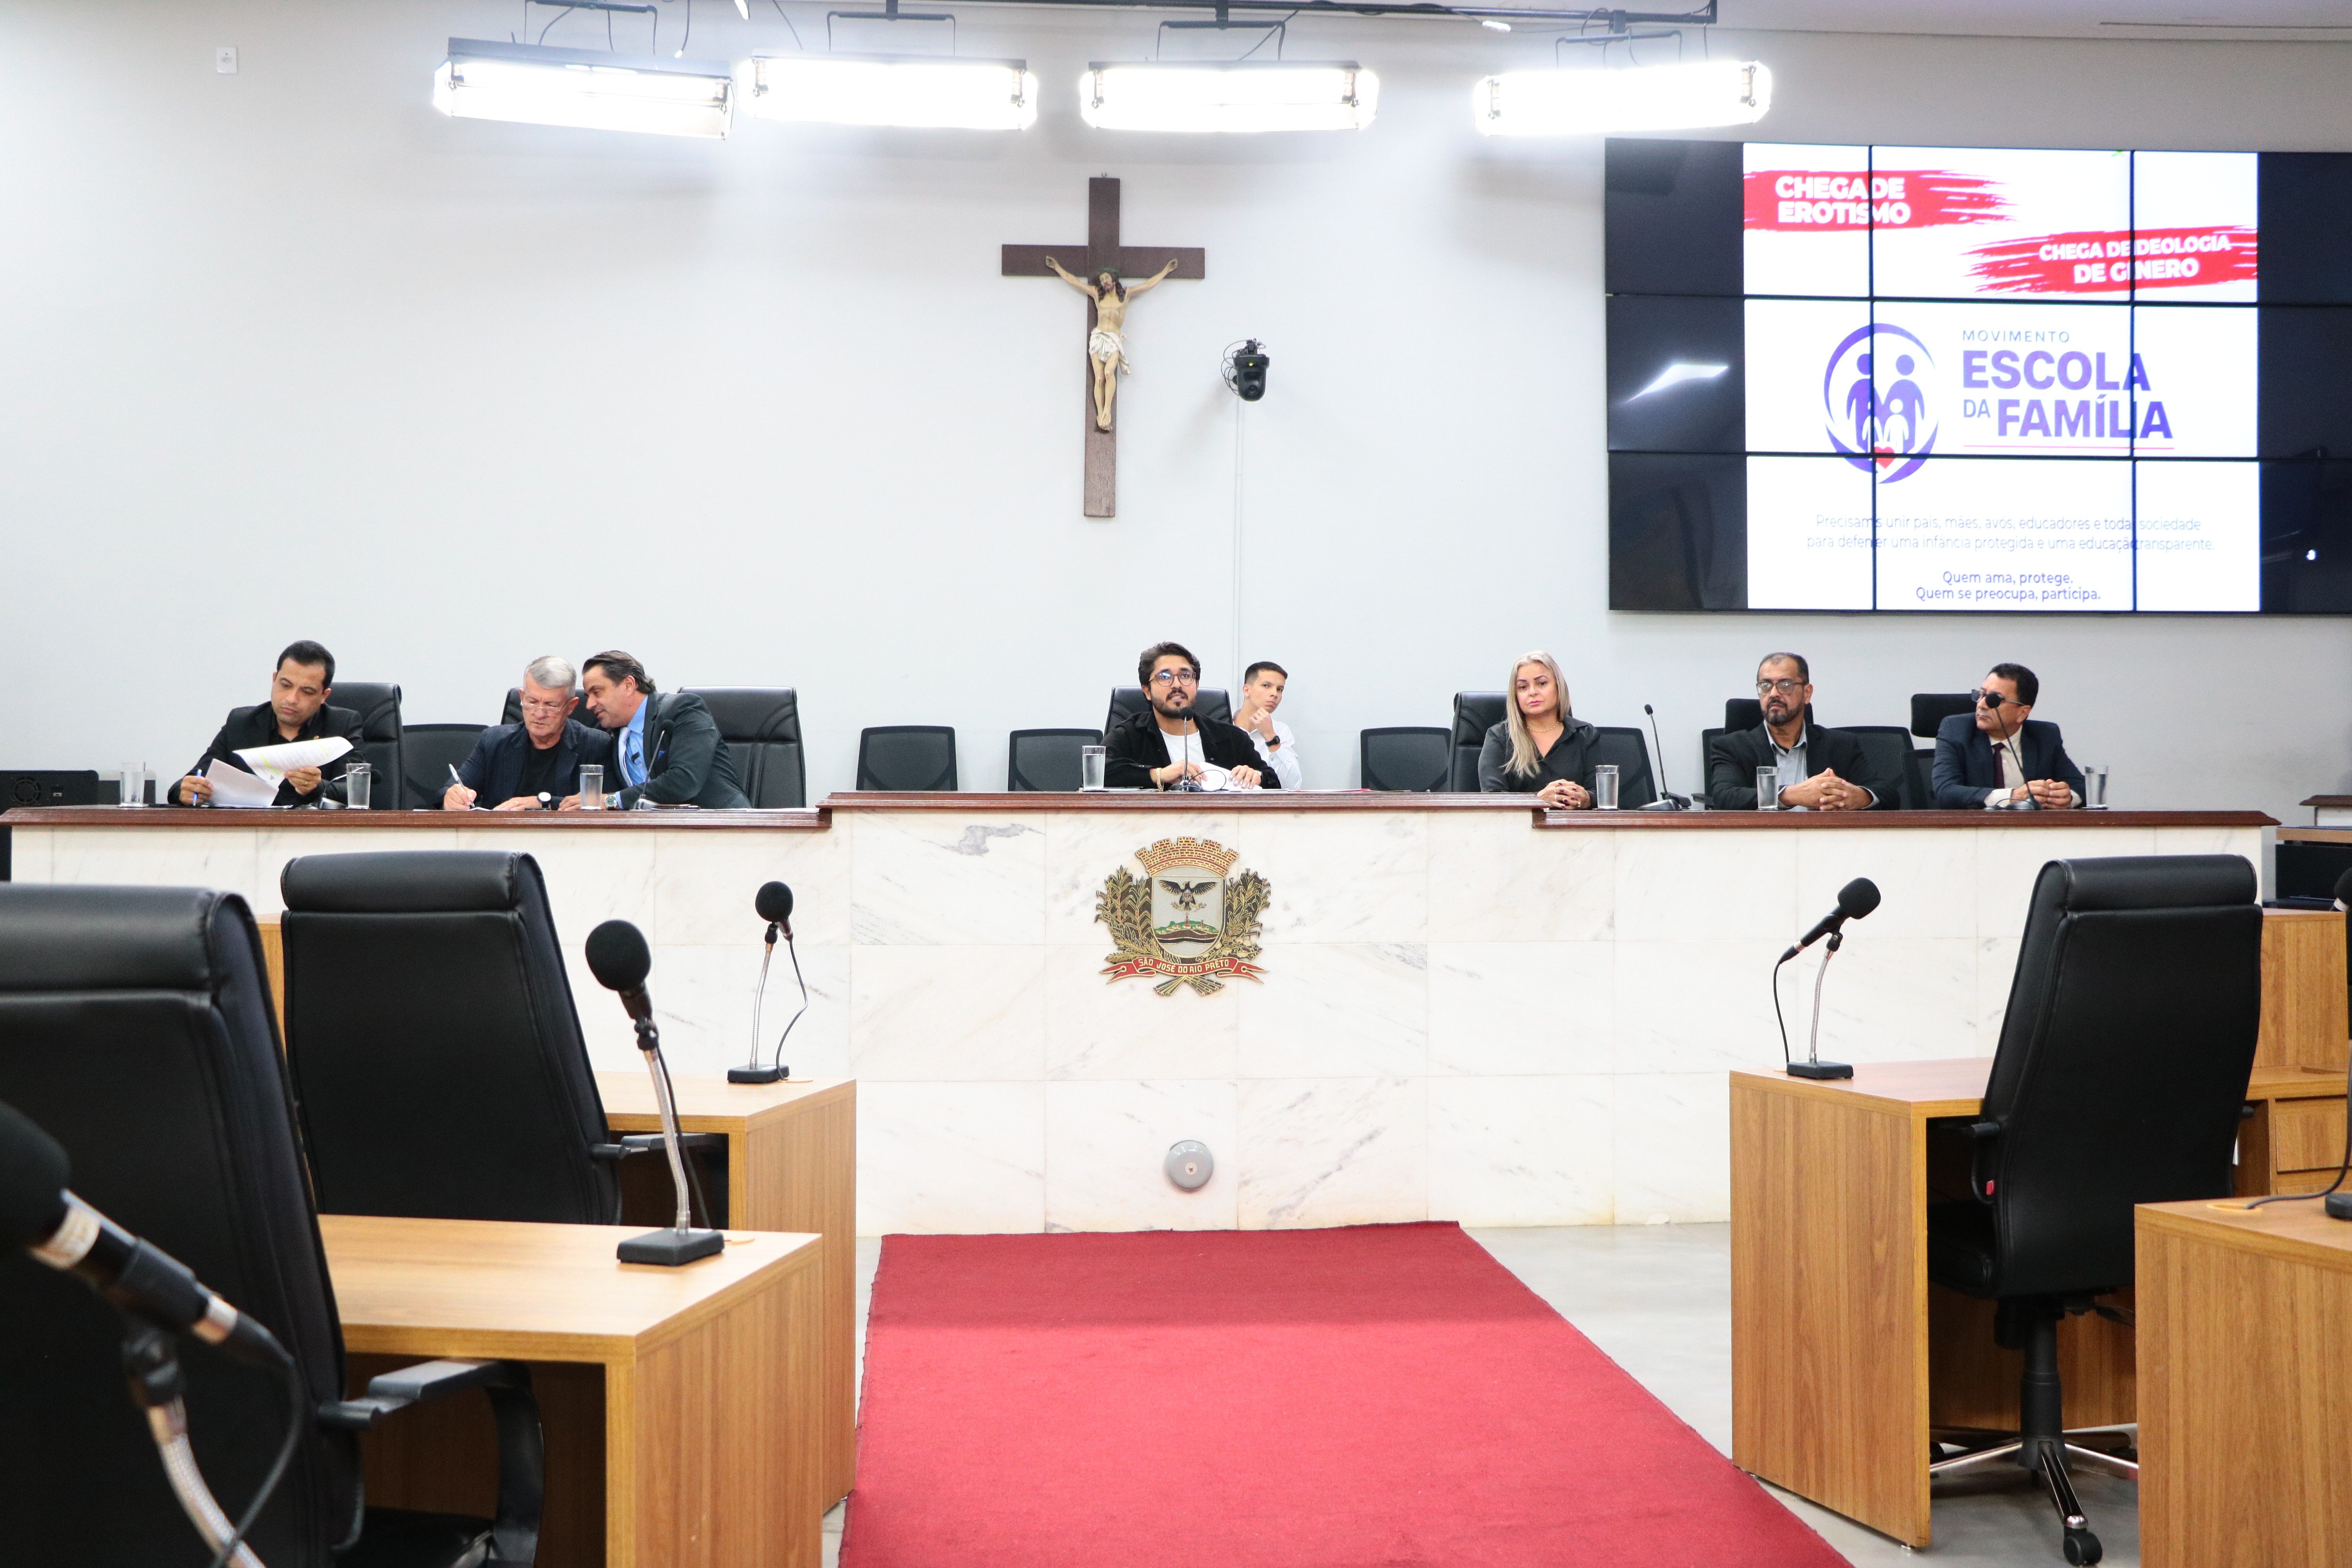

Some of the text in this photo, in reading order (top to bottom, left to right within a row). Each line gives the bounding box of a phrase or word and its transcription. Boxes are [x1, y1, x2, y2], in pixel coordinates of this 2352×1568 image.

[1775, 176, 1906, 200] CHEGA DE
[1778, 201, 1911, 224] EROTISMO
[2039, 241, 2104, 261] CHEGA
[2106, 240, 2131, 258] DE
[2074, 263, 2107, 283] DE
[1962, 330, 2070, 343] MOVIMENTO
[1963, 350, 2152, 391] ESCOLA
[1963, 399, 1991, 418] DA
[1817, 514, 2201, 531] Precisams unir pais, mães, avós, educadores e toda sociedade
[1807, 537, 1834, 550] para
[1838, 535, 1887, 548] defener
[1892, 538, 1919, 548] uma
[1923, 535, 1971, 548] infância
[1975, 536, 2034, 552] protegida
[2038, 539, 2044, 549] e
[2049, 539, 2075, 549] uma
[1943, 571, 2074, 587] Quem ama, protege.
[1916, 587, 2101, 603] Quem se preocupa, participa.
[1156, 962, 1176, 973] JOSÉ
[1189, 965, 1202, 973] RIO
